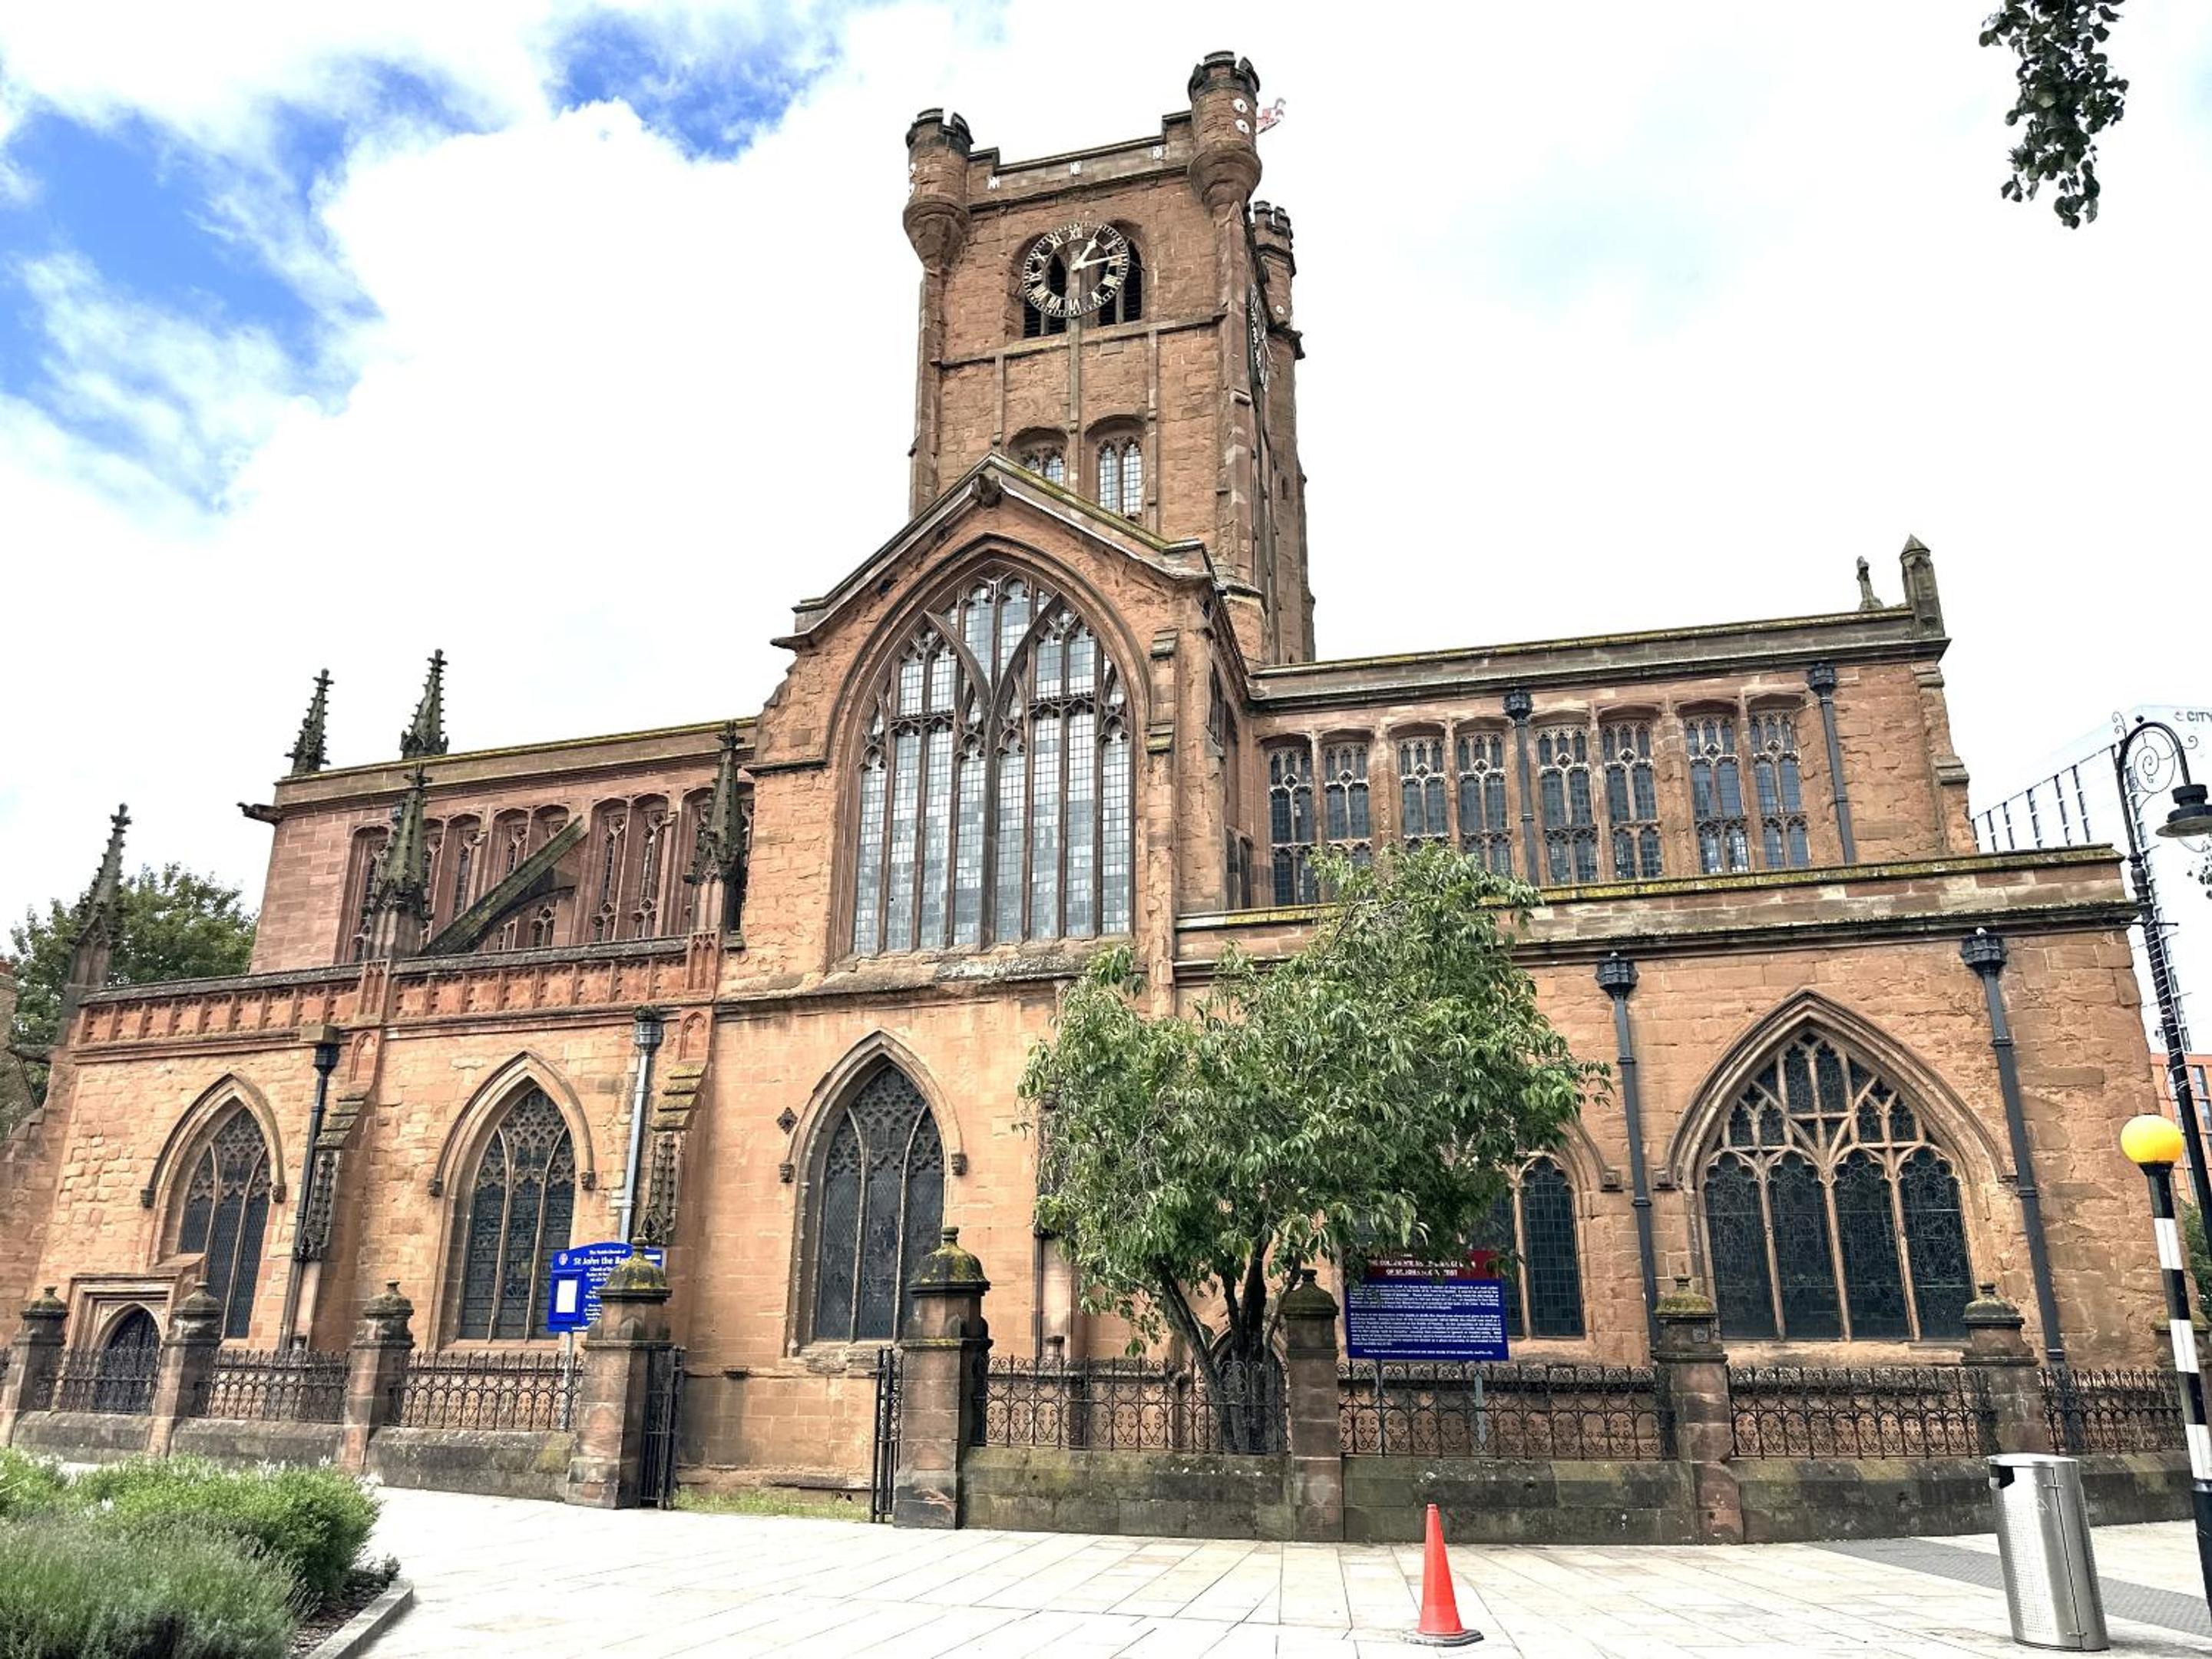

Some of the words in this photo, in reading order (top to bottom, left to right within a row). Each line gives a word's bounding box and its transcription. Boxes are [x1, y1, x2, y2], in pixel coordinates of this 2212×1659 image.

[2187, 711, 2212, 722] CITY
[583, 1256, 599, 1265] John
[601, 1256, 614, 1264] the
